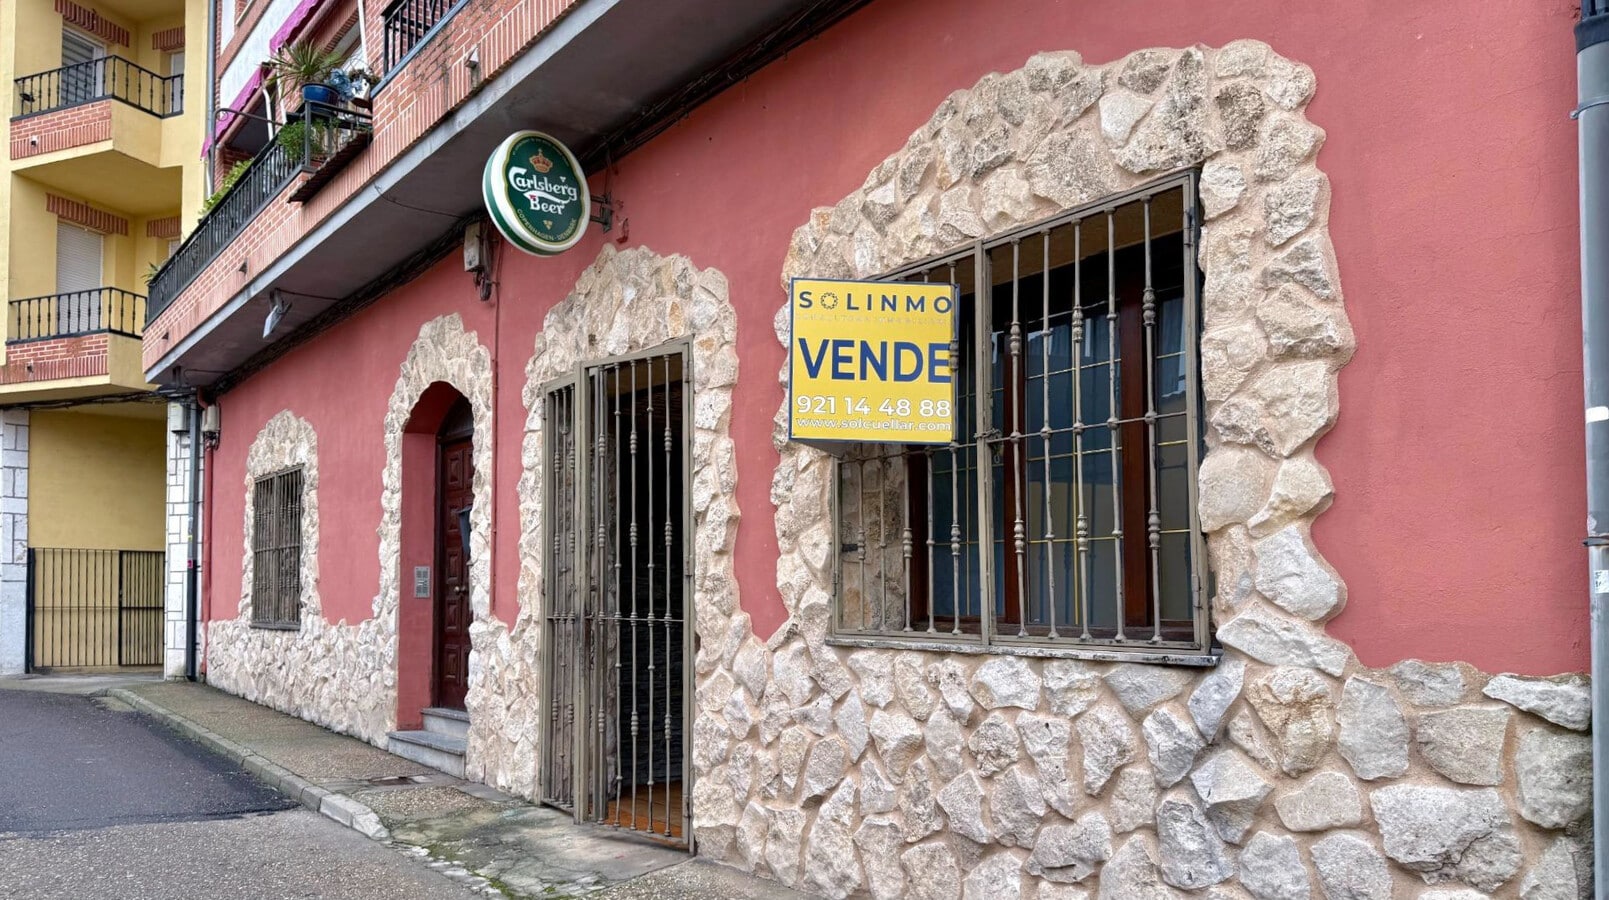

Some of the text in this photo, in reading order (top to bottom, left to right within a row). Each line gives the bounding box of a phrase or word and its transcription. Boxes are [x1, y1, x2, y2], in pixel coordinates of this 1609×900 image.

[508, 166, 577, 204] Carlsberg
[529, 197, 565, 215] Beer
[799, 291, 953, 314] SOLINMO
[798, 337, 952, 383] VENDE
[797, 395, 951, 418] 921 14 48 88
[796, 417, 951, 432] www.solcuellar.com
